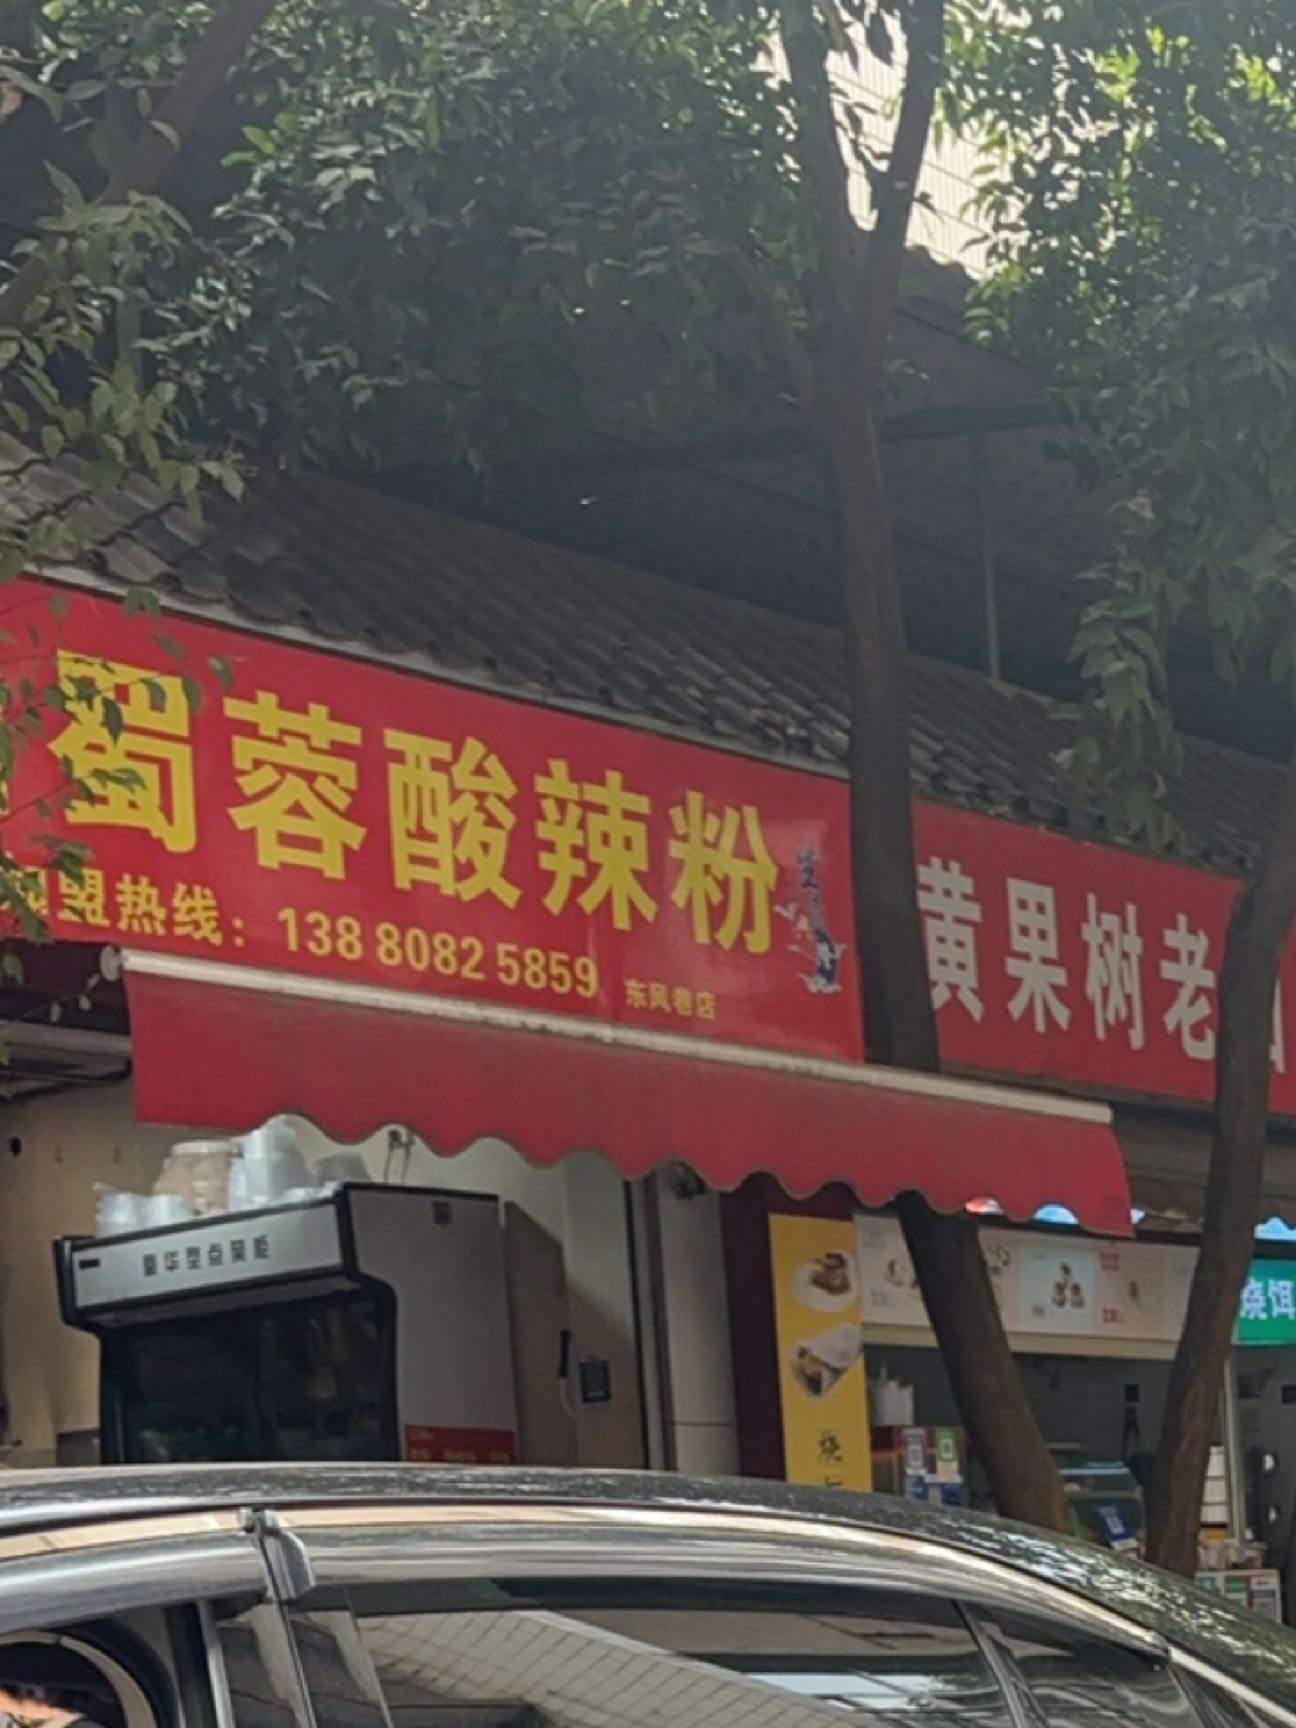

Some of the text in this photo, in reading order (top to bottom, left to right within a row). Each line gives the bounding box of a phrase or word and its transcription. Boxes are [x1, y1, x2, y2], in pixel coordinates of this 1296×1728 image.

[47, 648, 778, 953] 蜀蓉酸辣粉
[277, 907, 364, 963] 138
[376, 919, 486, 981] 8082
[496, 942, 600, 998] 5859
[625, 979, 716, 1020] 东风巷店
